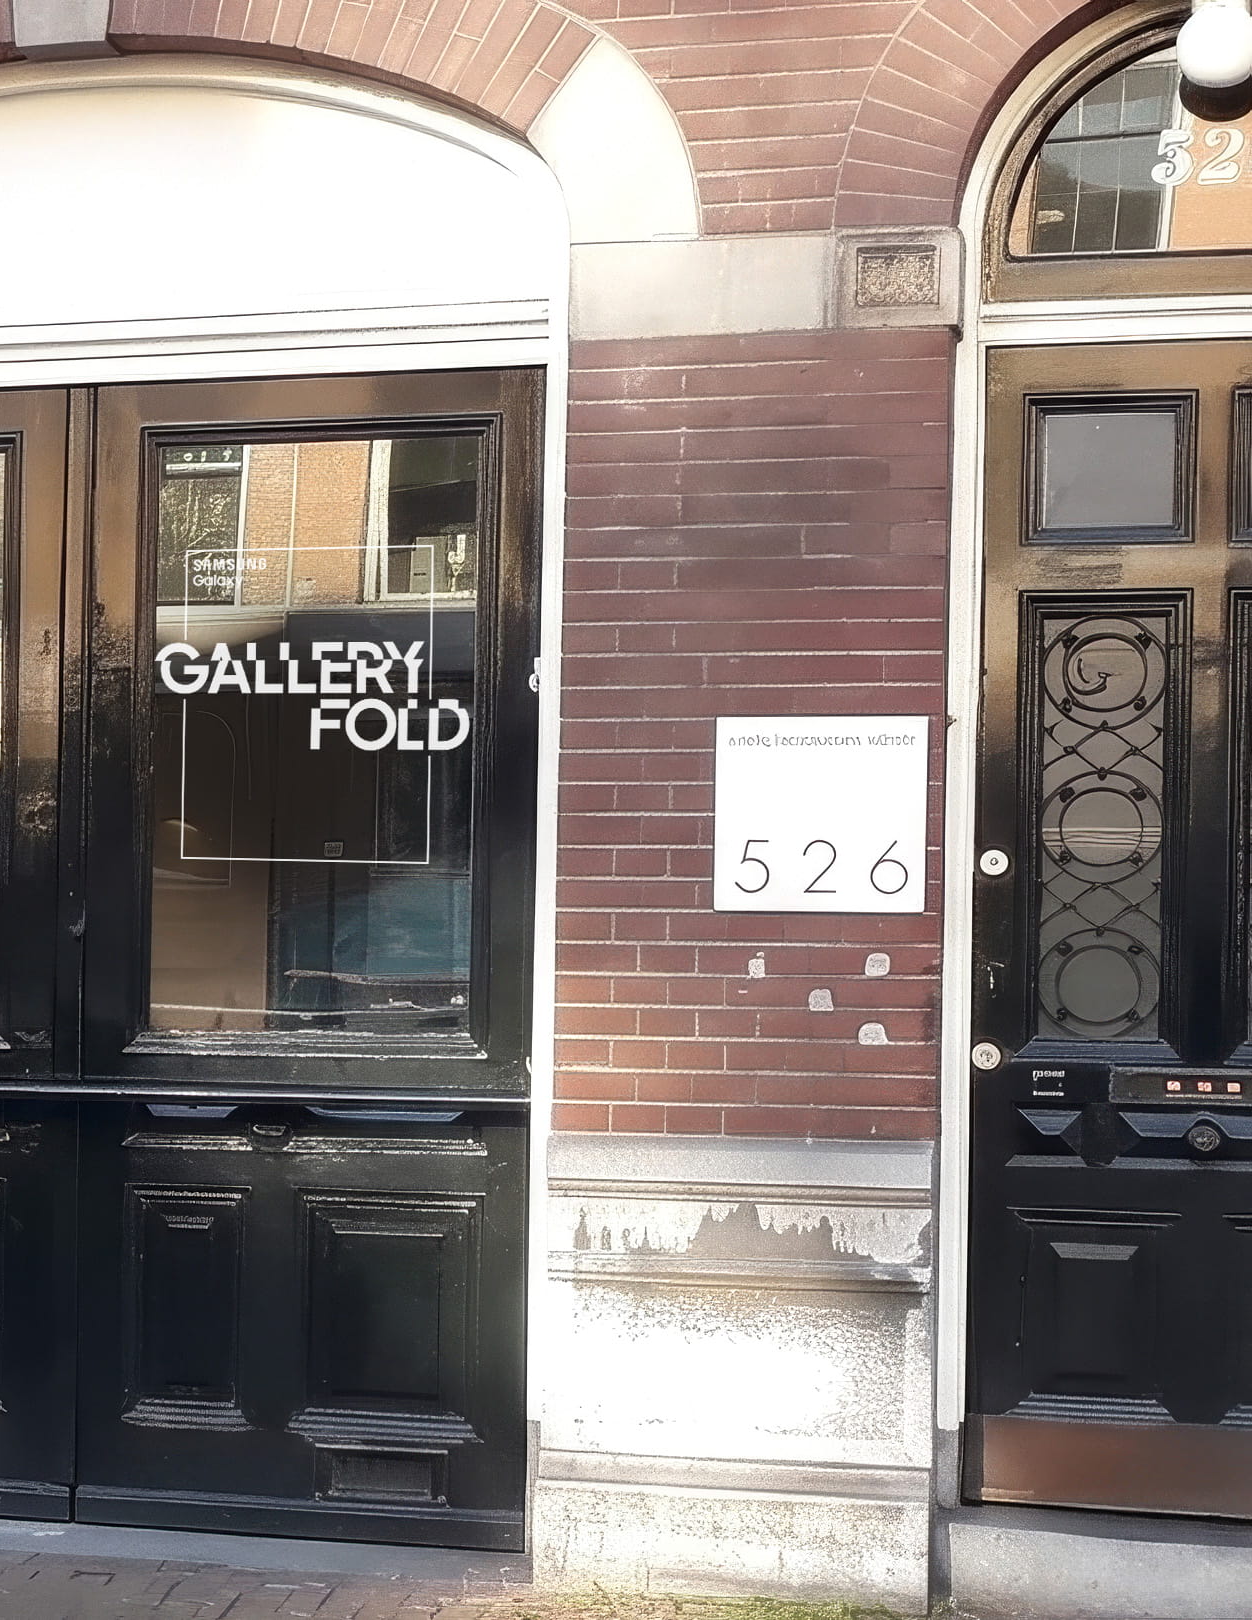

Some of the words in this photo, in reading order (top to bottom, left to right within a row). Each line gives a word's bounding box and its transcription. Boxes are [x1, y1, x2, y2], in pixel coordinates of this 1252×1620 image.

[192, 557, 267, 572] SAMSUNG
[192, 574, 243, 588] Galaxy
[155, 641, 425, 694] GALLERY
[310, 698, 470, 751] FOLD
